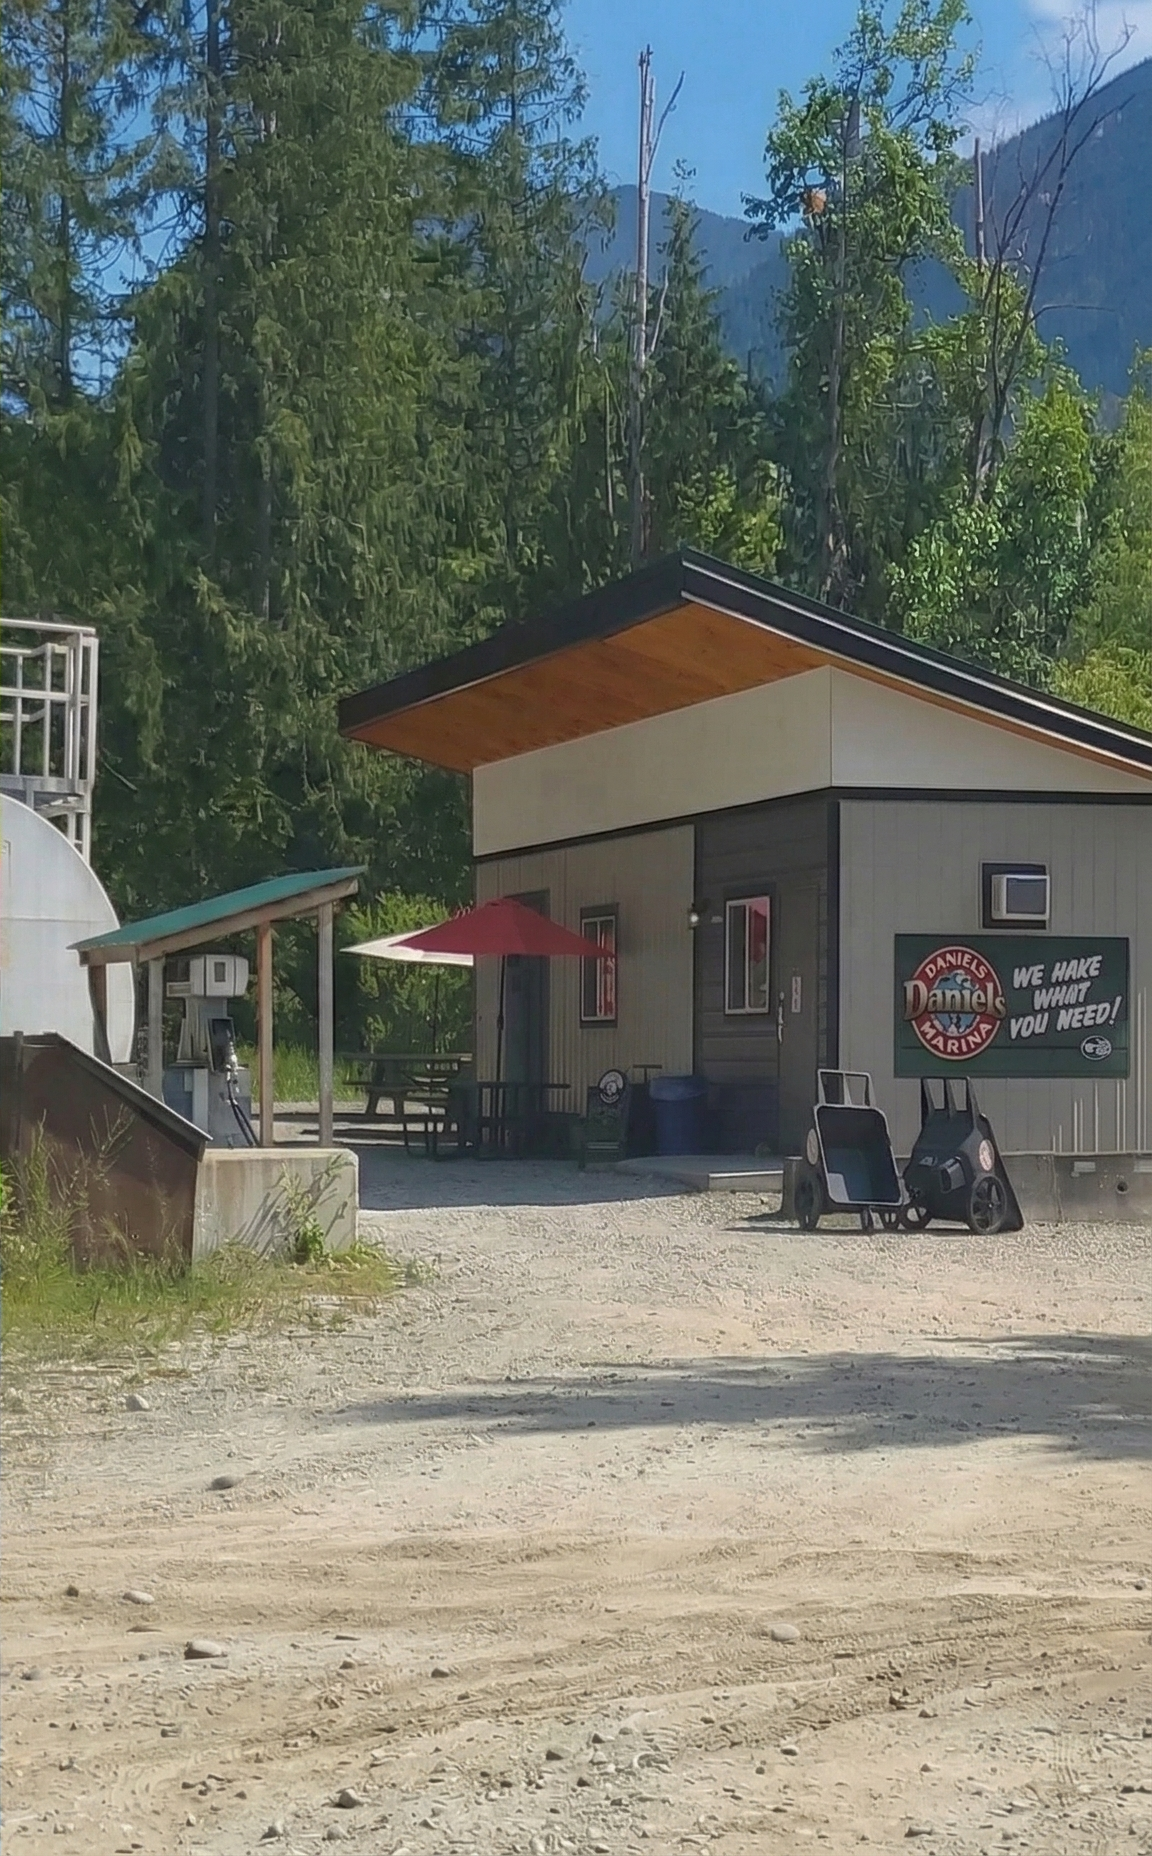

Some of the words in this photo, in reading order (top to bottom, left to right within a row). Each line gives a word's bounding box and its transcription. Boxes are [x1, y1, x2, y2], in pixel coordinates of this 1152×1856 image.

[924, 952, 988, 979] DANIELS
[1012, 964, 1045, 989] WE
[903, 979, 1007, 1021] Daniels
[1033, 981, 1091, 1010] WHAT
[1010, 1012, 1049, 1040] YOU
[1056, 995, 1123, 1031] NEED!
[920, 1021, 993, 1054] MARINA
